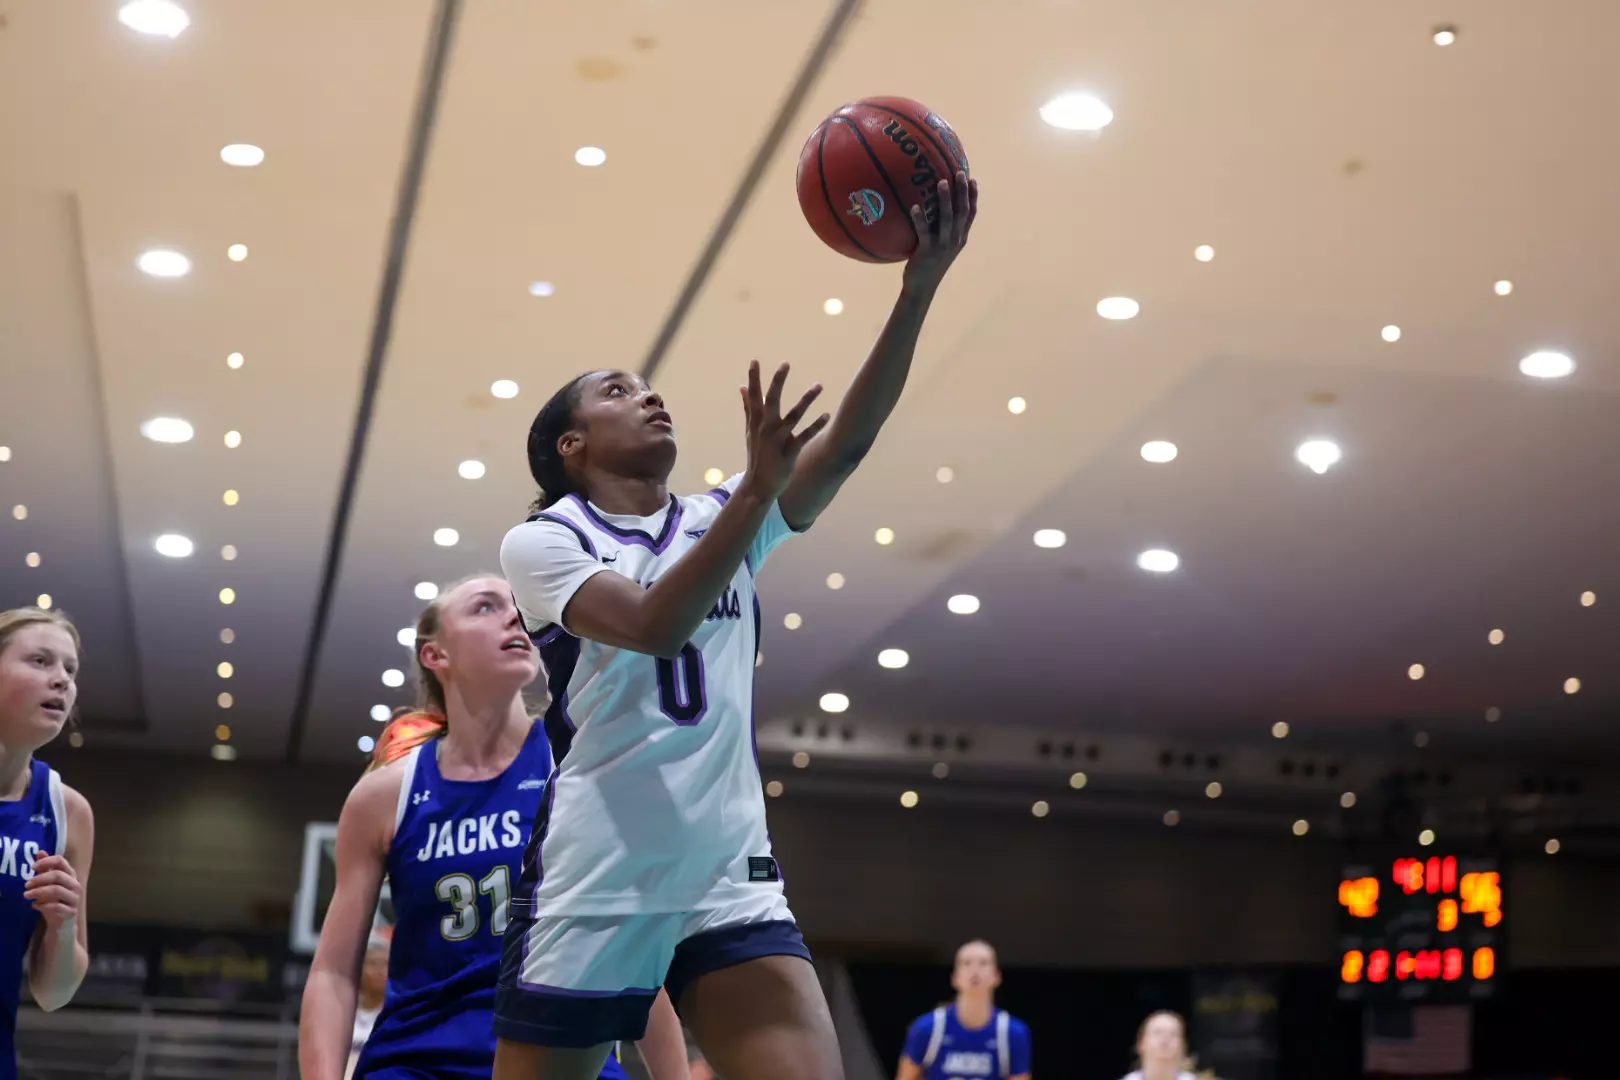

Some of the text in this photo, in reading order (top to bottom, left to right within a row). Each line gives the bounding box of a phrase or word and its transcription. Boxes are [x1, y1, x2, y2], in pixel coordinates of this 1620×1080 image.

[657, 642, 708, 726] 0
[416, 809, 521, 863] JACKS
[435, 865, 512, 942] 31
